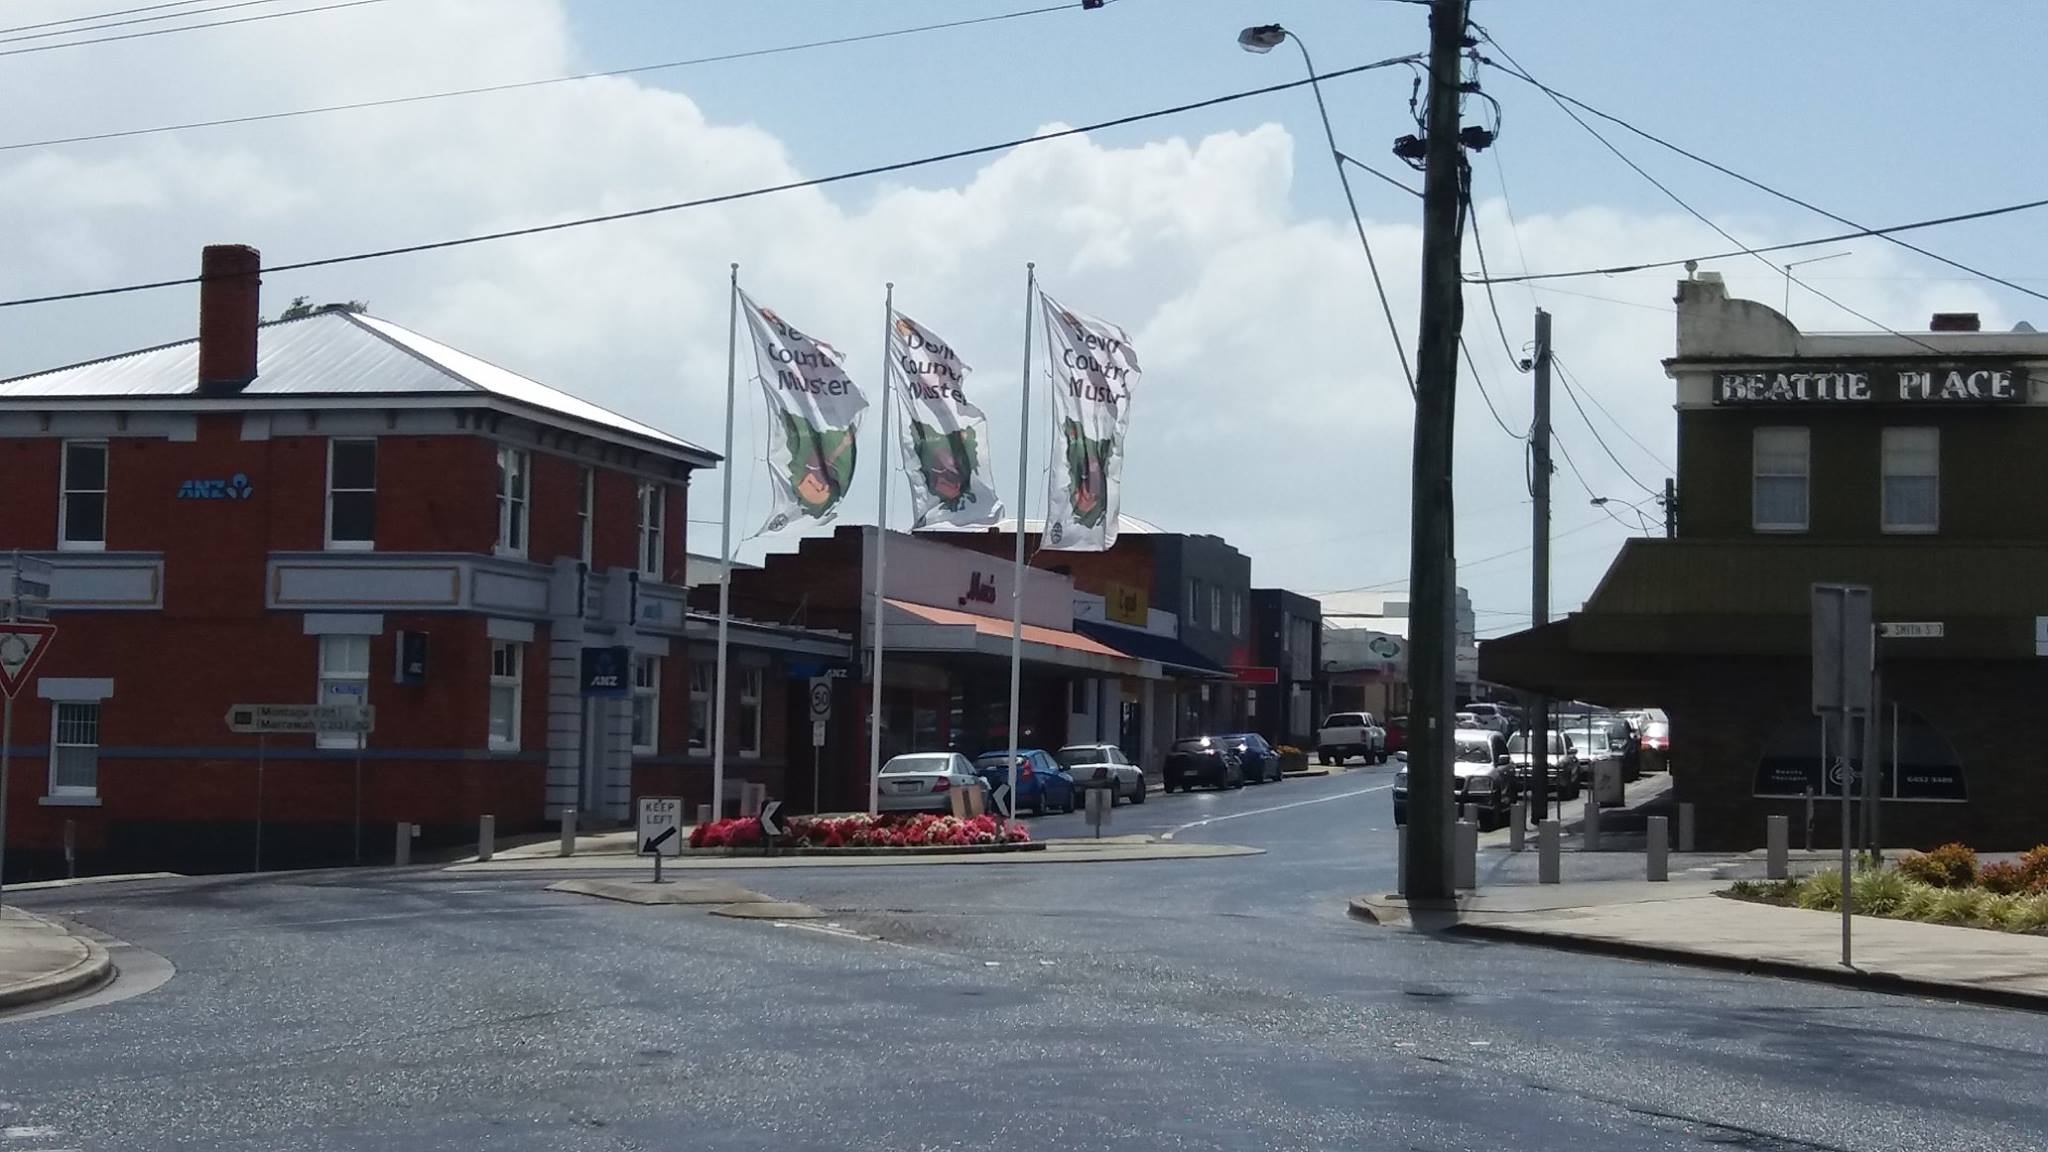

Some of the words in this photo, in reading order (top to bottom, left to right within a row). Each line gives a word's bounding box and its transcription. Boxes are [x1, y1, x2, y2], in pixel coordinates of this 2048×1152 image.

[1721, 371, 1872, 400] BEATTIE
[1899, 370, 2016, 399] PLACE
[176, 479, 225, 498] ANZ
[591, 675, 619, 686] ANZ
[815, 691, 829, 706] 50
[646, 803, 674, 811] KEEP
[647, 815, 672, 824] LEFT
